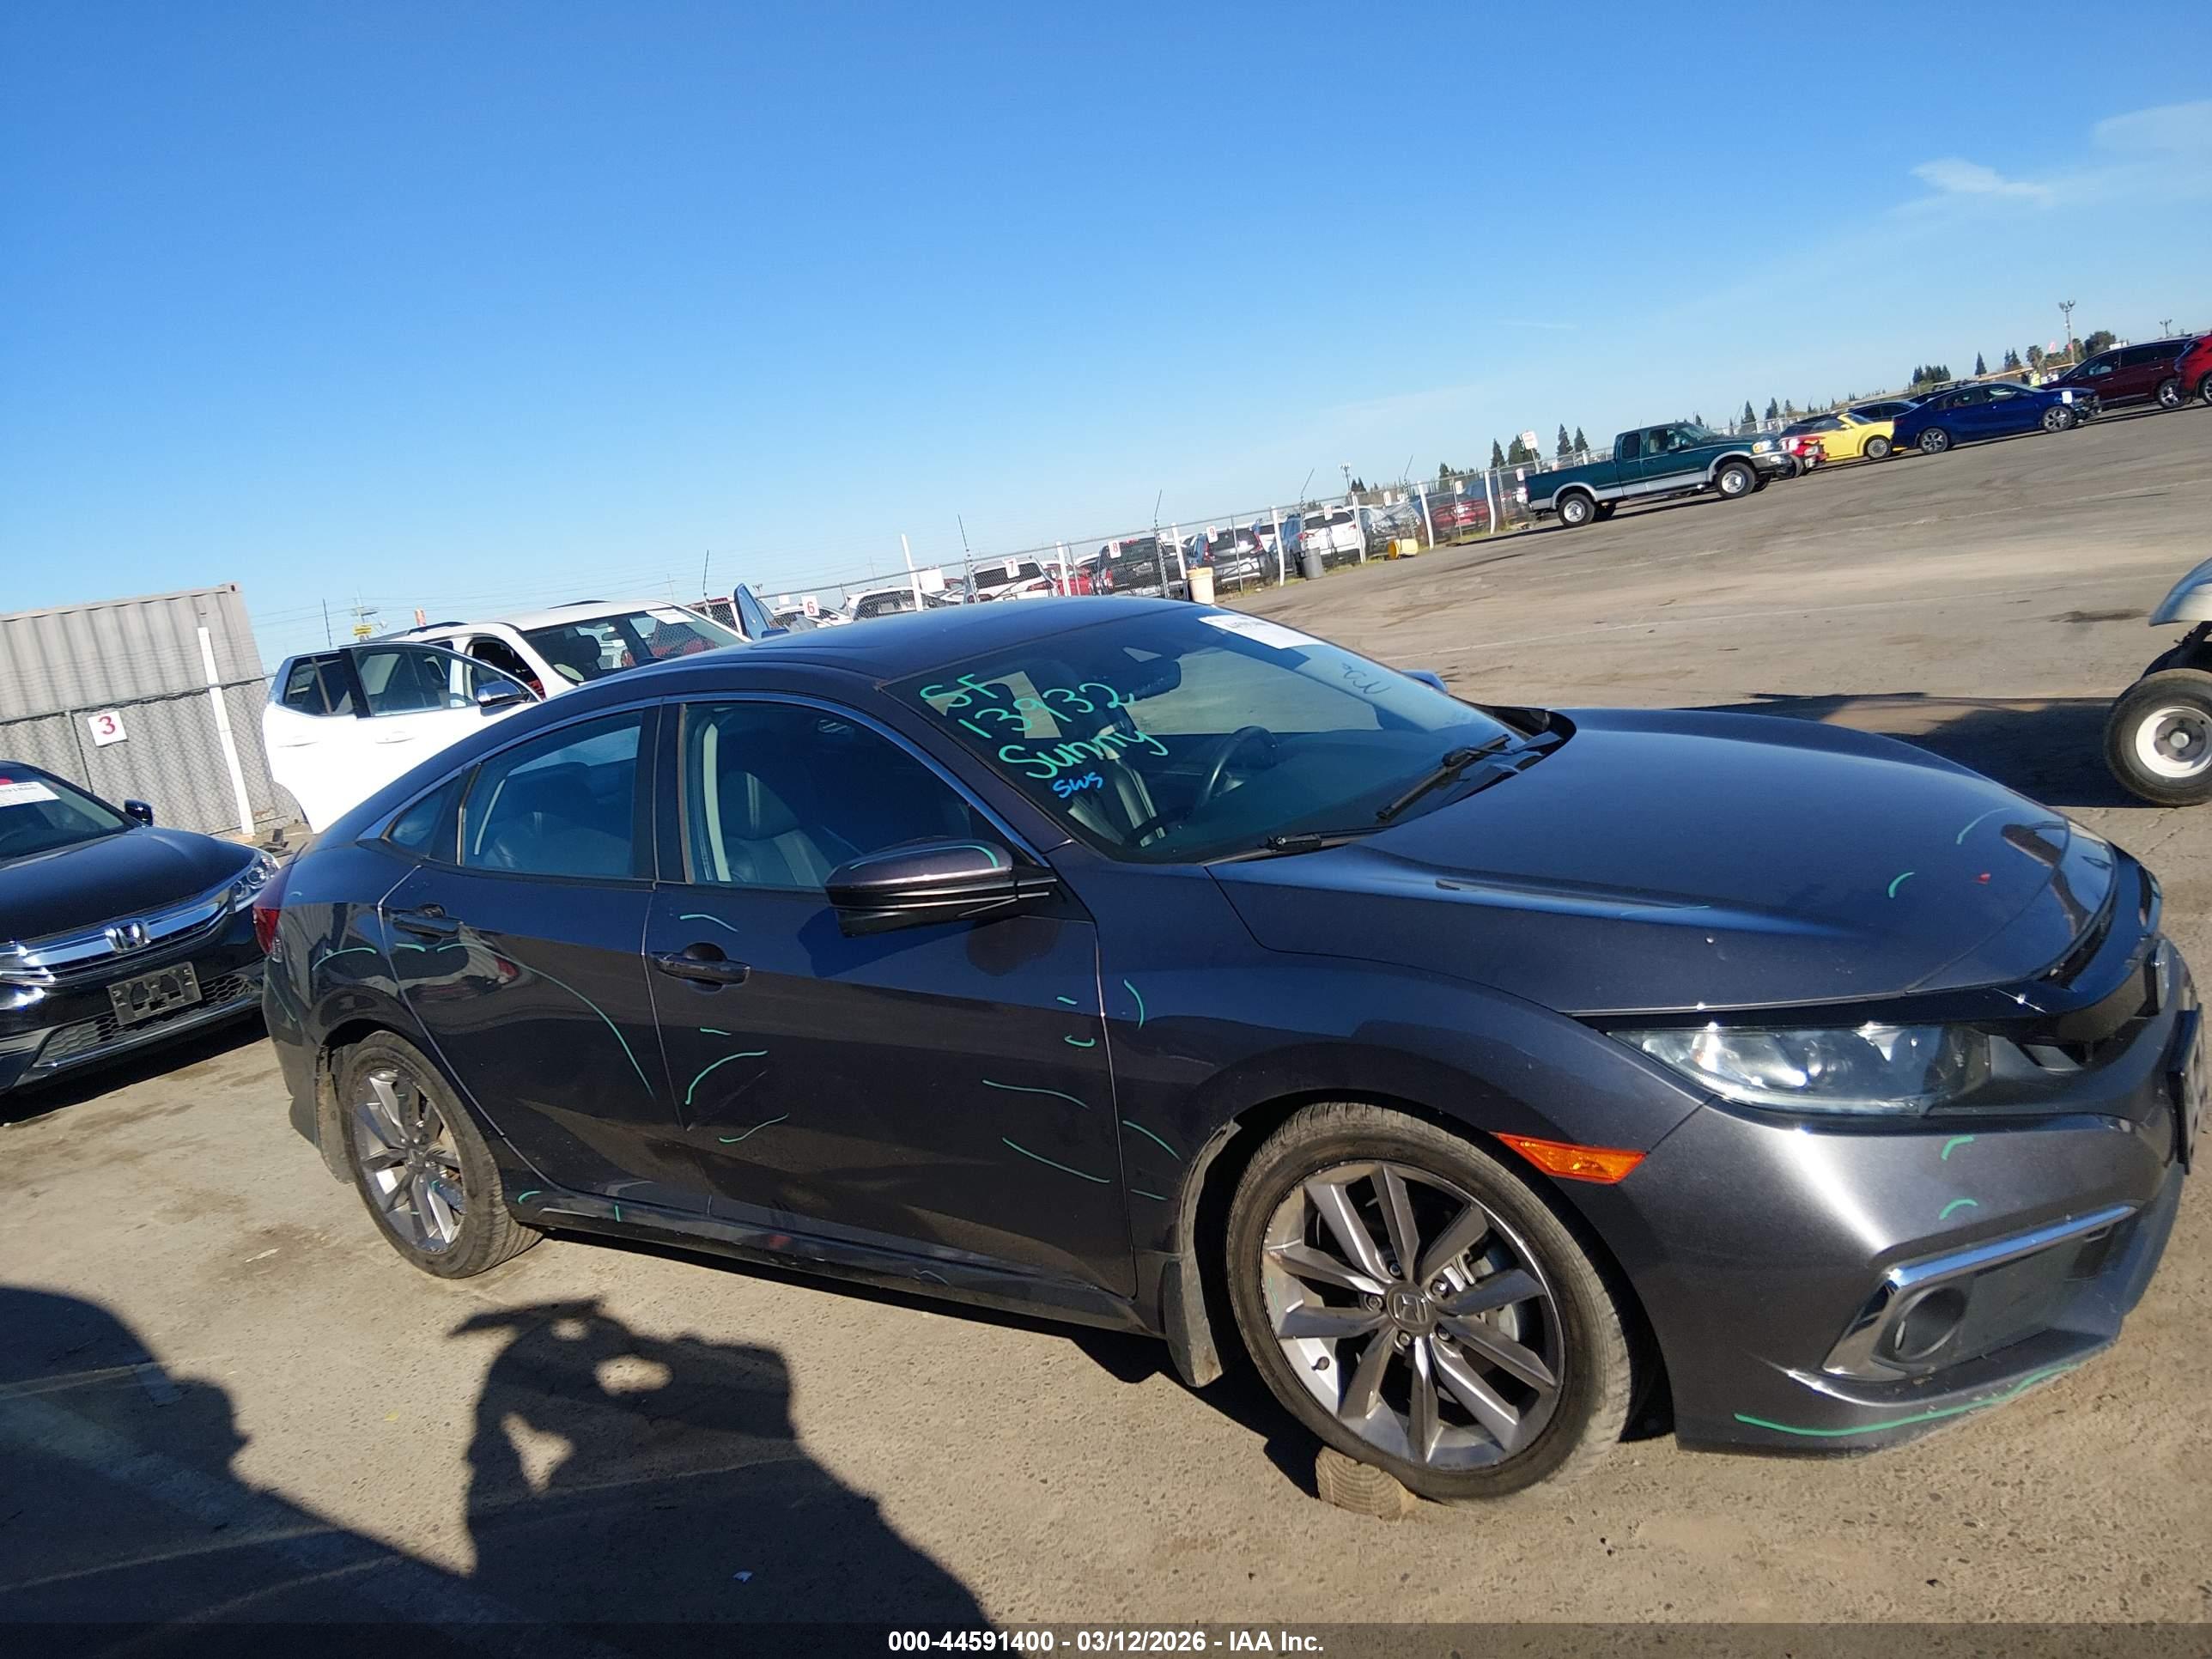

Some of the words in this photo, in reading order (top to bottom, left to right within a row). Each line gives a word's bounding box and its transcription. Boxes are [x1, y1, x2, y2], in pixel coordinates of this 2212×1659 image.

[1209, 527, 1215, 538] 9
[1112, 542, 1119, 553] 8
[1008, 561, 1014, 572] 7
[807, 601, 815, 614] 6
[957, 683, 1134, 738] 13932
[98, 715, 116, 735] 3
[999, 730, 1169, 779] Sunny
